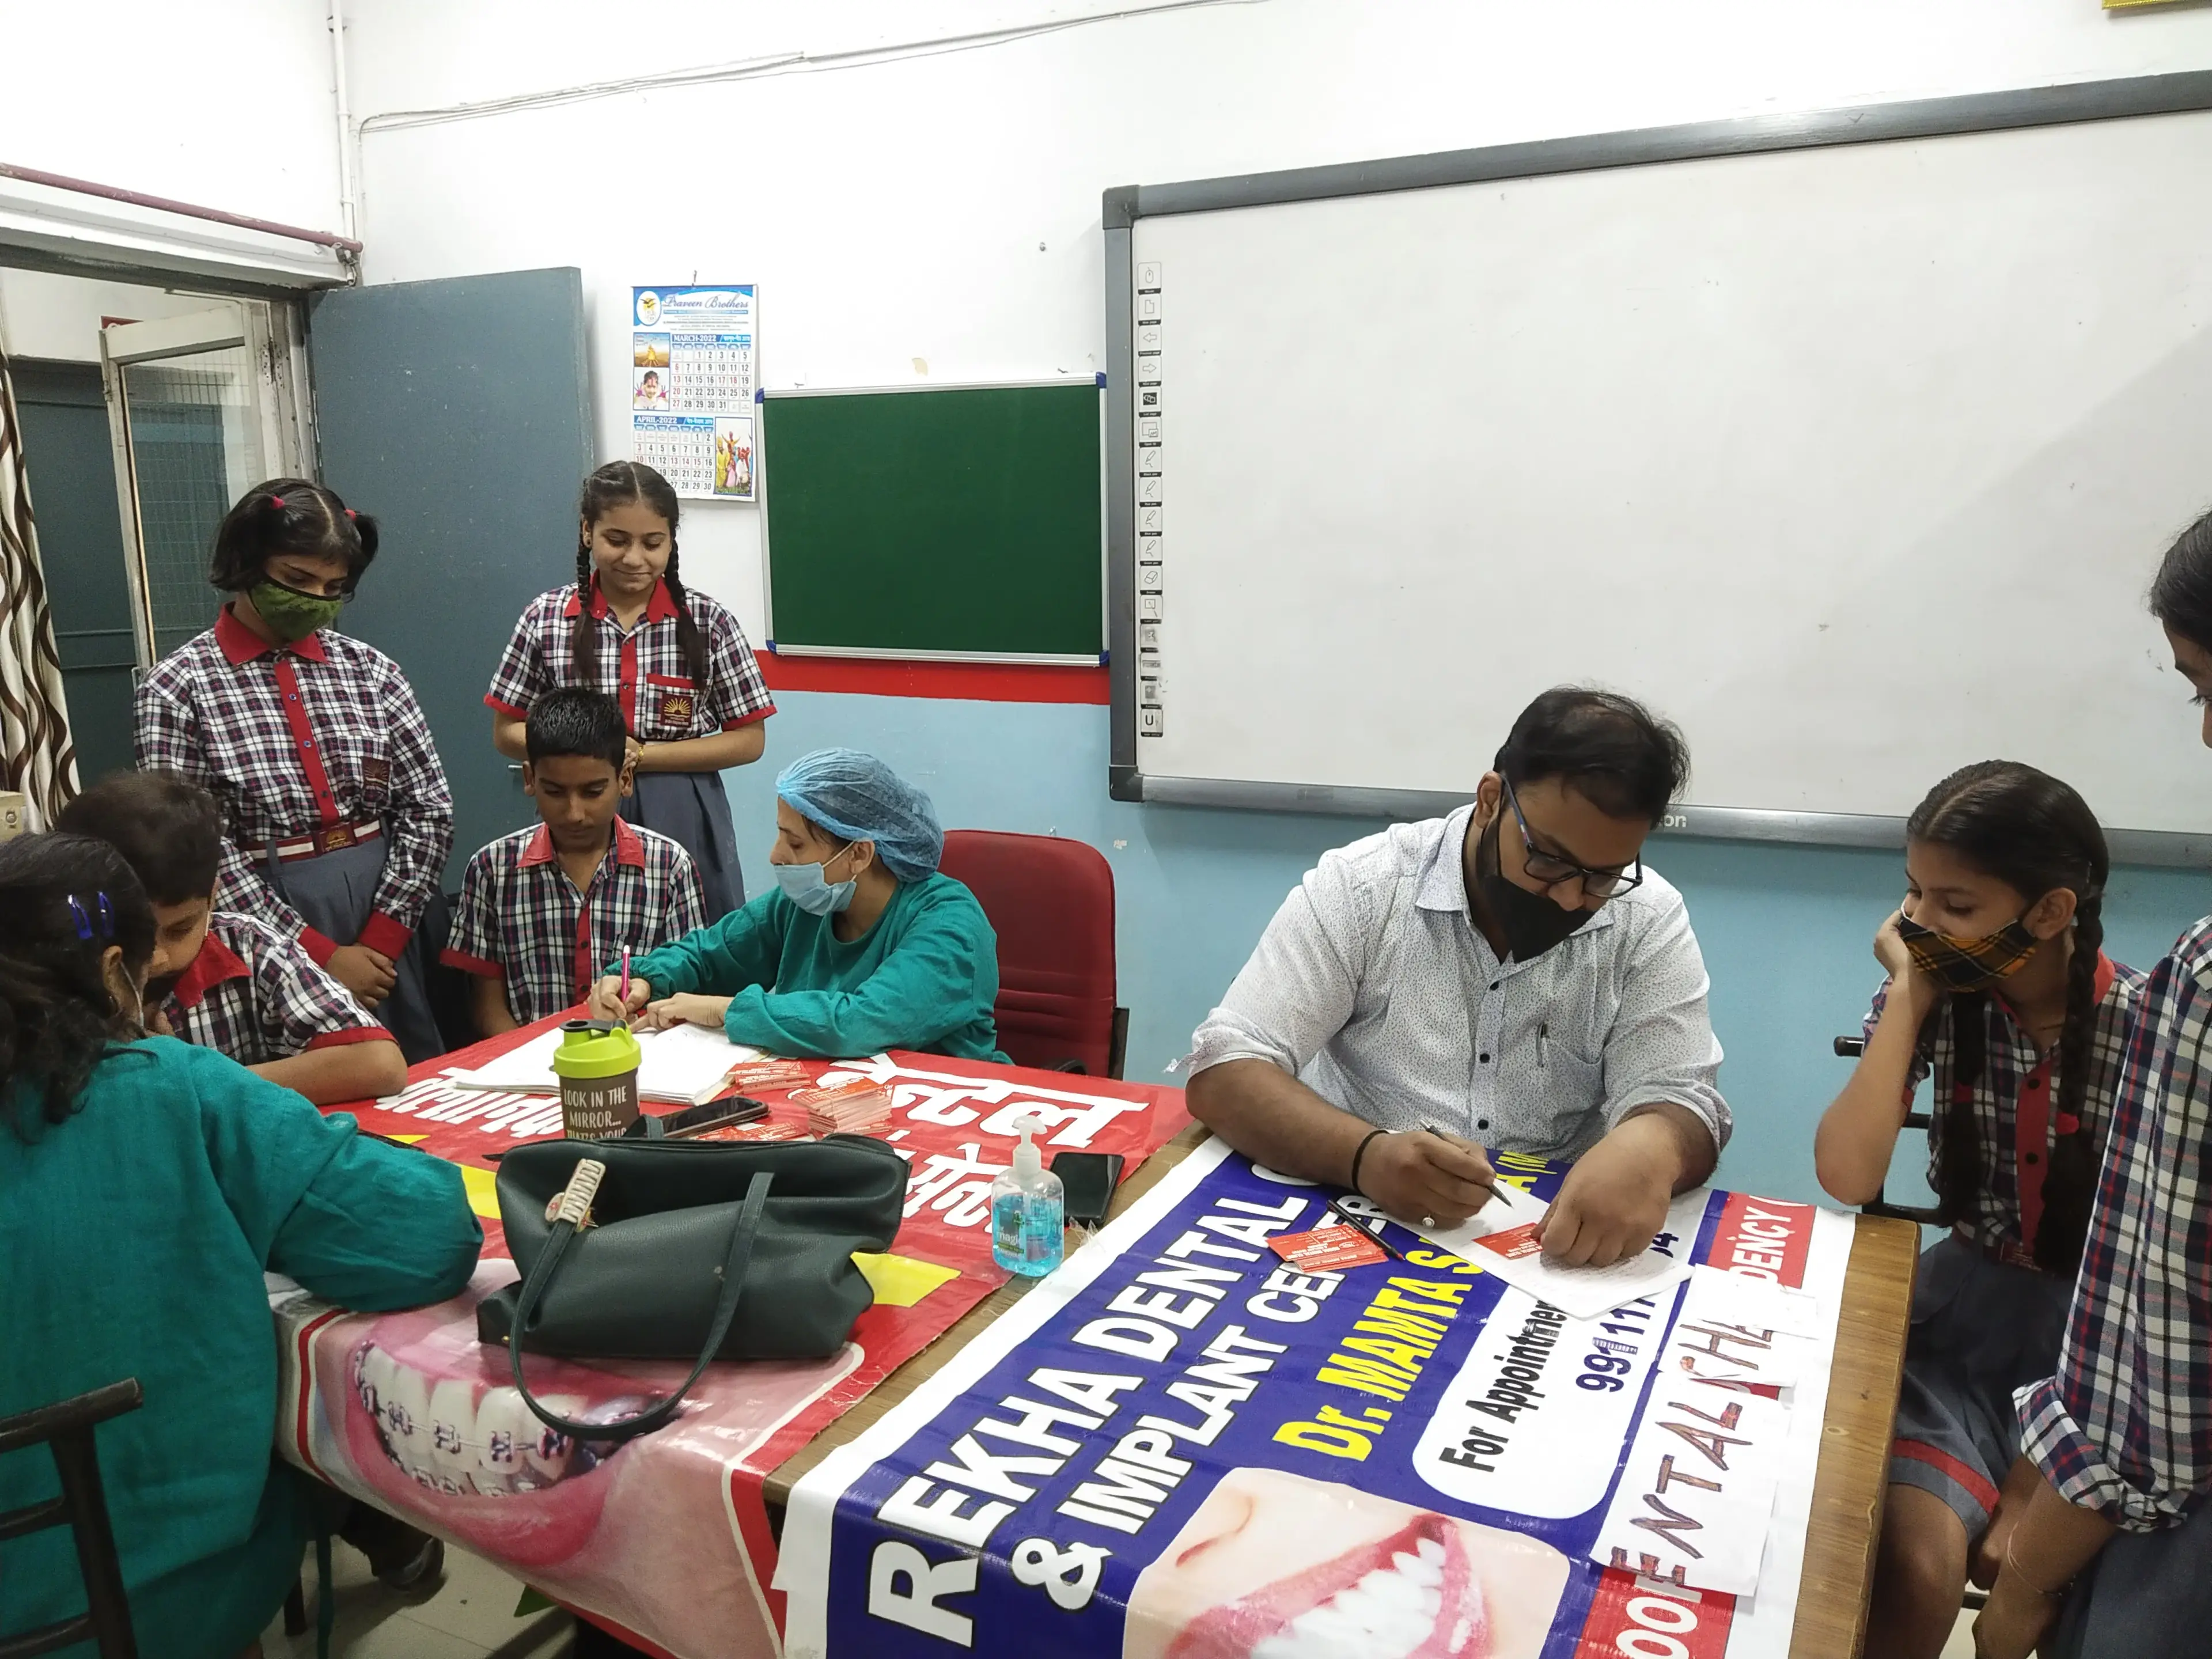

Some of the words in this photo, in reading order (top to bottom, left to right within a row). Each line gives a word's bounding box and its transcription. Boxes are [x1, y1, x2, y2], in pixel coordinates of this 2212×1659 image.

[662, 294, 702, 308] Praveen
[704, 292, 748, 308] Brothers
[564, 1088, 587, 1108] LOOK
[591, 1090, 603, 1108] IN
[608, 1086, 627, 1105] THE
[569, 1110, 622, 1129] MIRROR...
[1315, 1277, 1474, 1402] MAMTA
[868, 1367, 1144, 1649] REKHA
[1070, 1196, 1309, 1363] DENTAL
[1054, 1324, 1289, 1535] IMPLANT
[1271, 1404, 1393, 1462] Dr.
[1438, 1426, 1510, 1473] For
[1610, 1402, 1753, 1586] ENTAL
[1012, 1537, 1114, 1611] &
